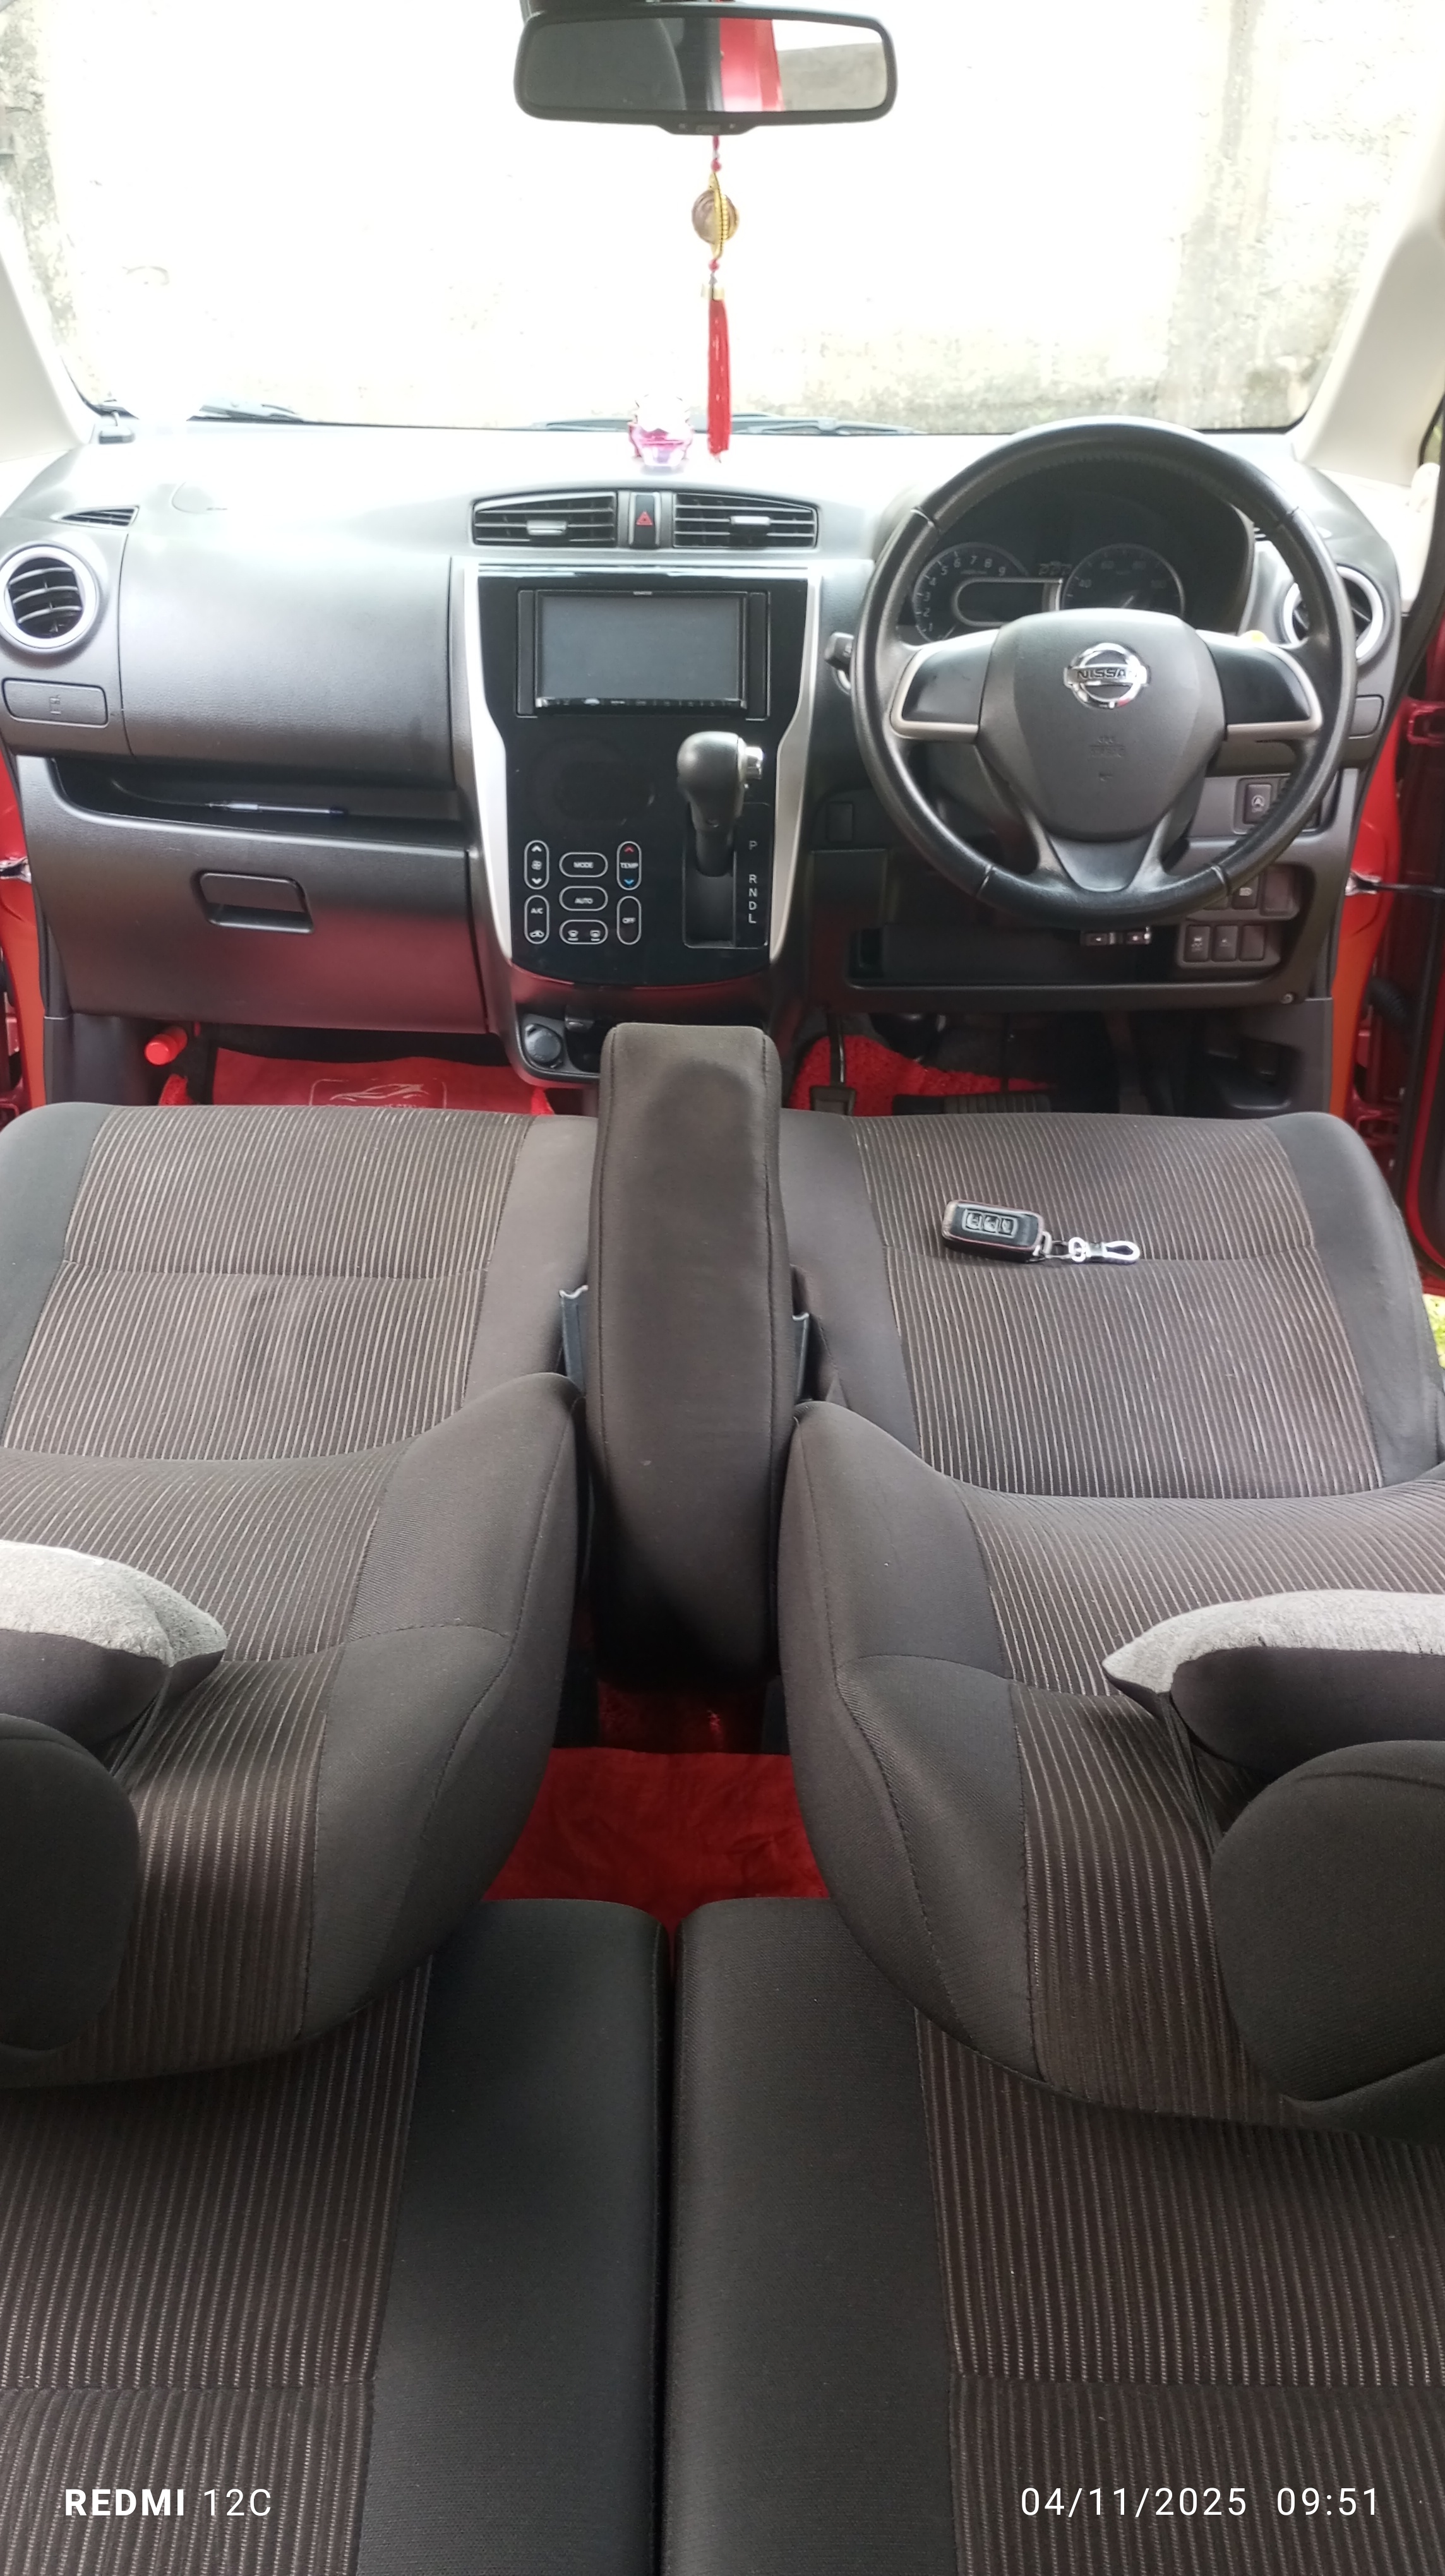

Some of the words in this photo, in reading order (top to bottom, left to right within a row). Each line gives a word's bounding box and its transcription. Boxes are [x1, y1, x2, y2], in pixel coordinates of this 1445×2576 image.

[941, 566, 948, 576] 5
[923, 607, 930, 617] 2
[748, 840, 758, 850] P
[748, 874, 757, 884] R
[748, 888, 758, 897] N
[748, 901, 757, 910] D
[748, 914, 757, 924] L
